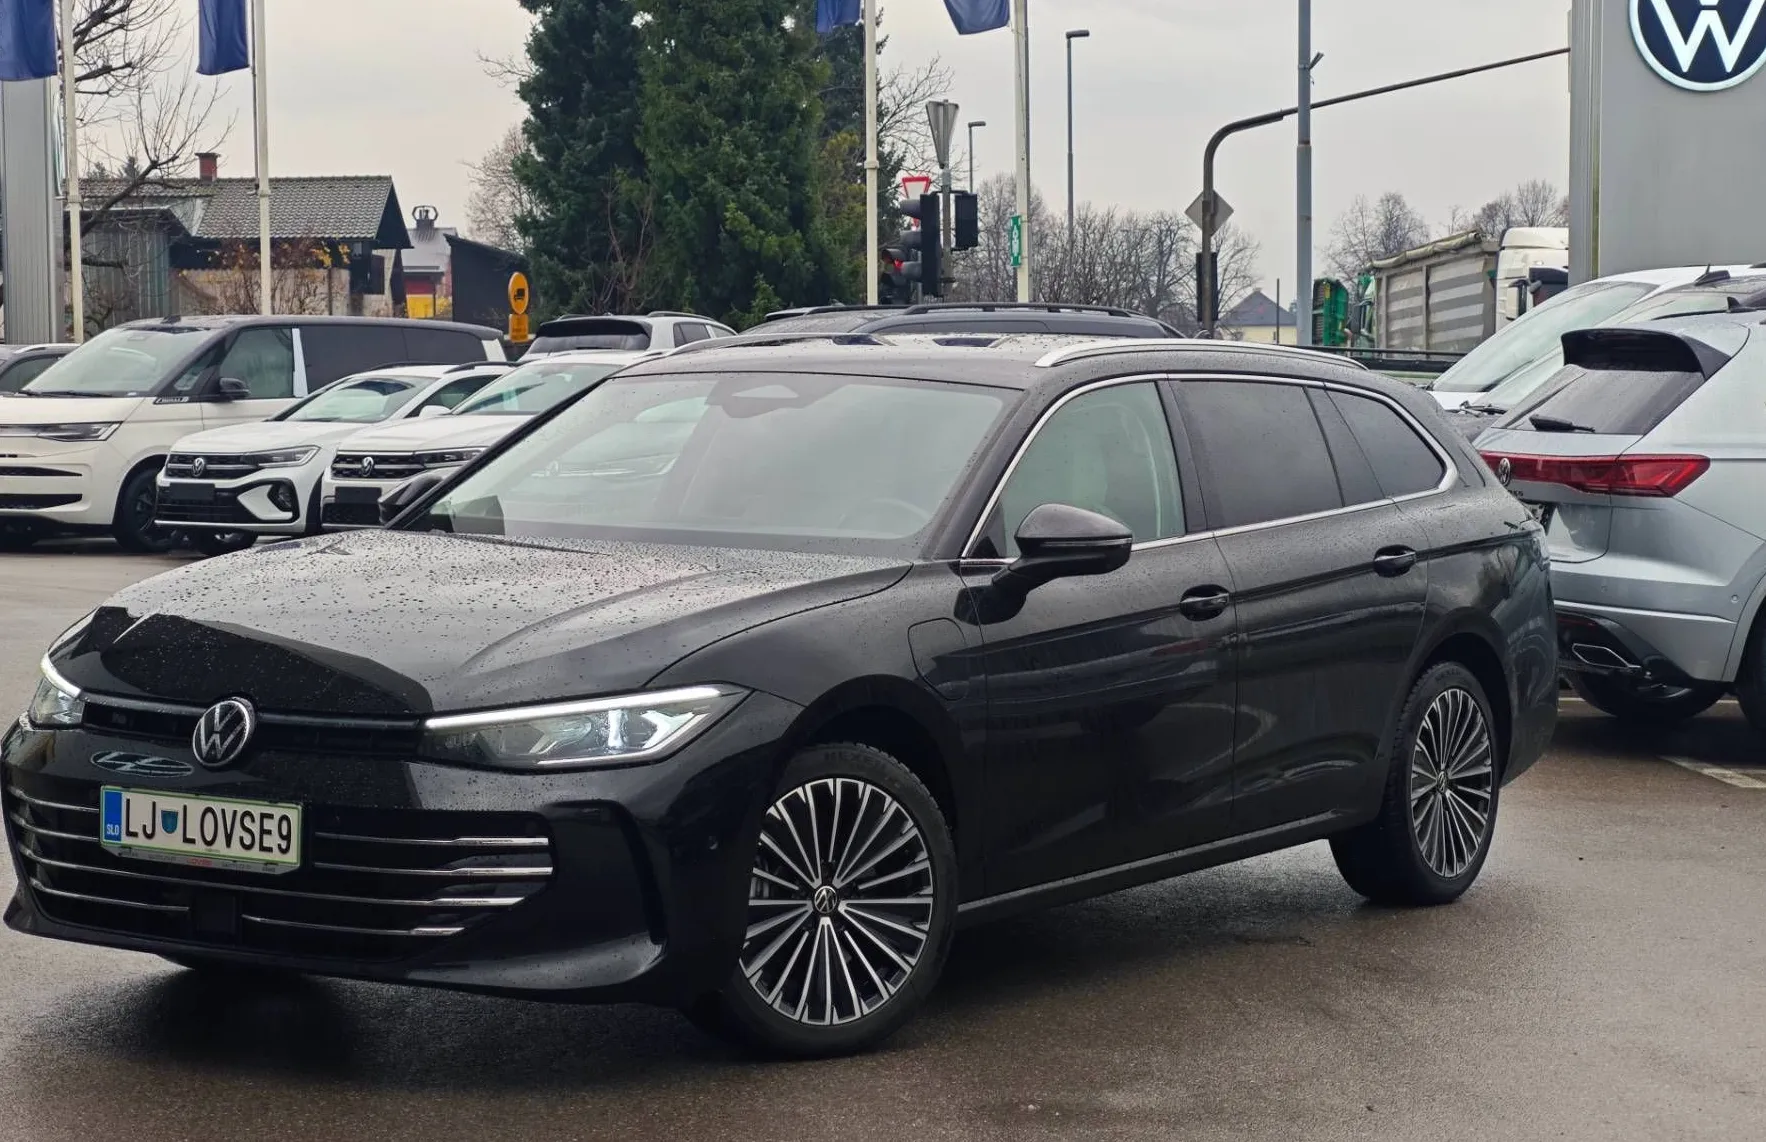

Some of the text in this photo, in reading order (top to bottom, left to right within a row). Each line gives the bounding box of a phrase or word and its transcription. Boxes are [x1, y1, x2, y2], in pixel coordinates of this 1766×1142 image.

[1646, 0, 1766, 73] W
[198, 702, 249, 761] VW
[106, 823, 120, 836] SLO
[125, 798, 292, 855] LJ LOVSE9
